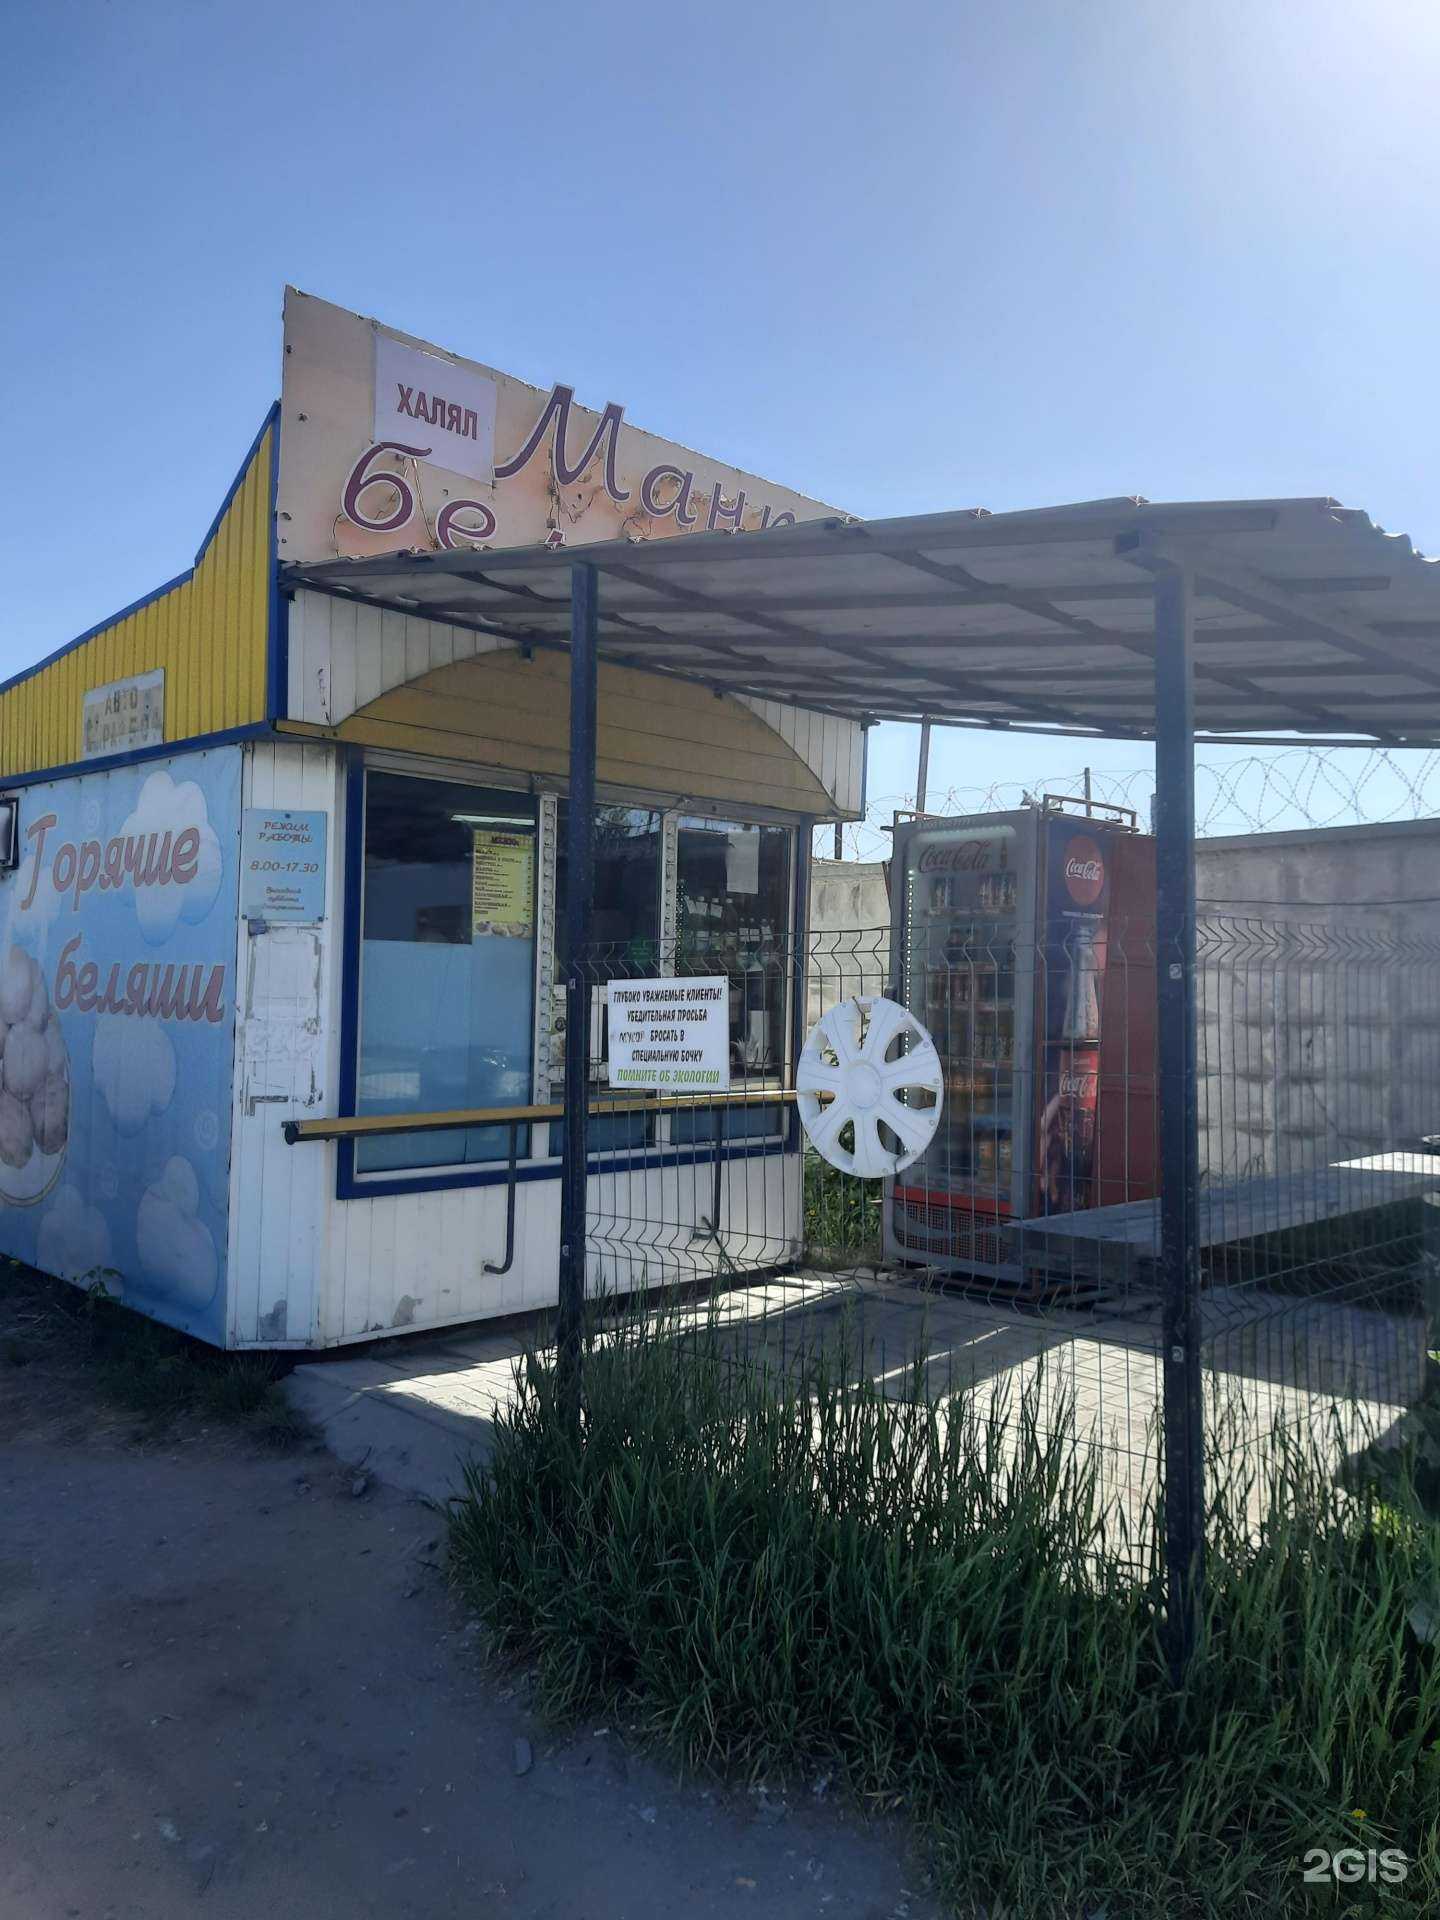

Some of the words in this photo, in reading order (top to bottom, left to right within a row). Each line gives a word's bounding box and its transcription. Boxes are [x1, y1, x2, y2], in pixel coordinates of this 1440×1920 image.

[397, 383, 478, 441] ХАЛЯЛ
[342, 440, 565, 550] бе
[20, 814, 201, 912] Горячие
[249, 860, 320, 873] 8.00-17.30
[54, 932, 225, 1022] беляши
[613, 991, 640, 1003] ГЛУБОКО
[642, 988, 685, 1002] УВАЖАЕМЫЕ
[686, 988, 722, 1001] КЛИЕНТЫ!
[627, 1009, 676, 1023] УБЕДИТЕЛЬНАЯ
[677, 1009, 708, 1021] ПРОСЬБА
[650, 1029, 678, 1042] БРОСАТЬ
[680, 1029, 685, 1041] В
[631, 1050, 680, 1063] СПЕЦИАЛЬНУЮ
[681, 1050, 704, 1062] БОЧКУ
[617, 1069, 657, 1082] ПОМНИТЕ
[659, 1070, 671, 1082] ОБ
[672, 1070, 720, 1083] ЭКОЛОГИИ
